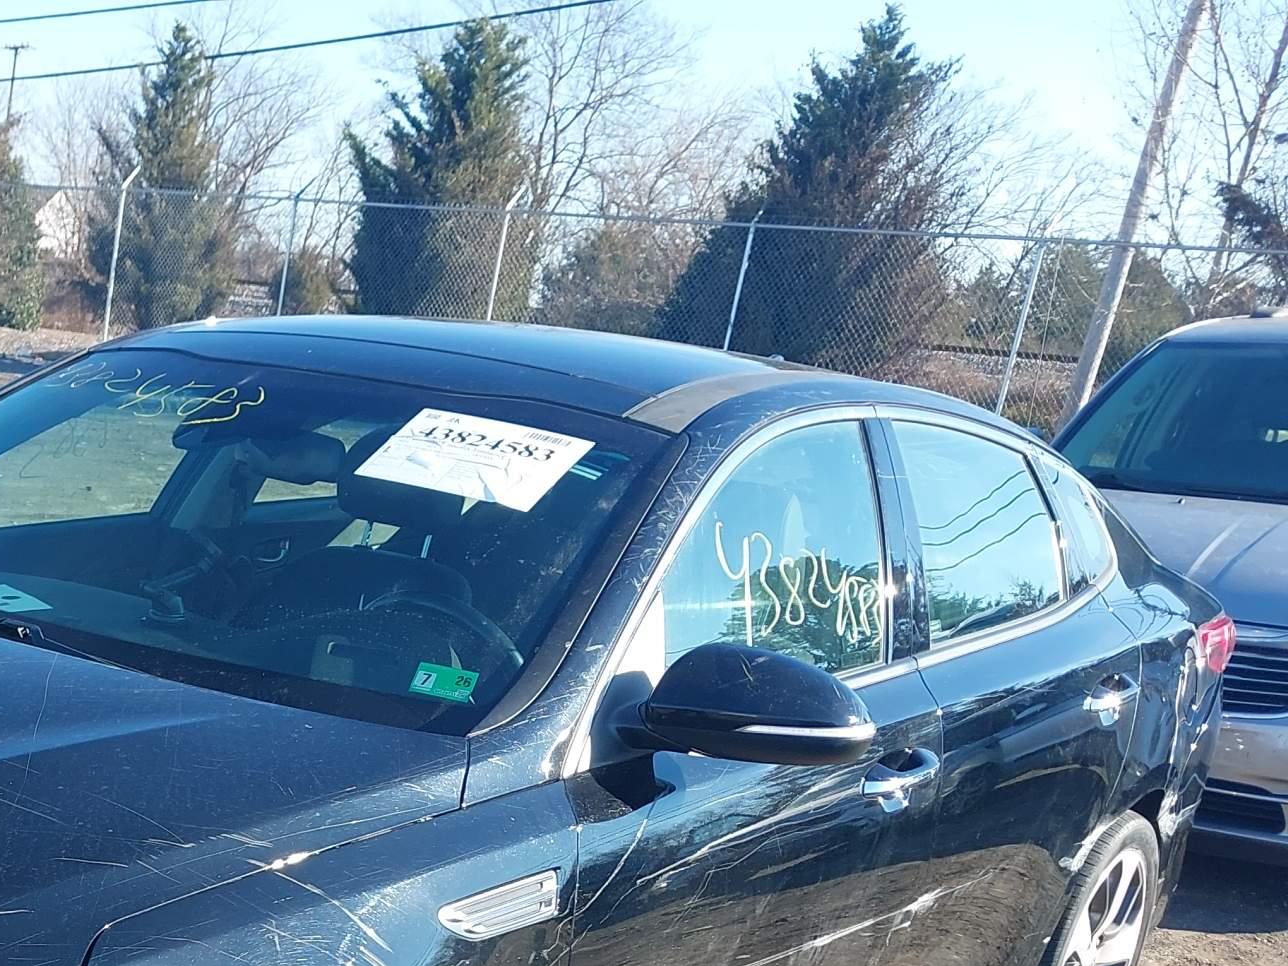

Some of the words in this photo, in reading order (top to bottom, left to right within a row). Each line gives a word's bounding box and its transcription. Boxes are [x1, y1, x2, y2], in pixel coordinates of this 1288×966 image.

[419, 425, 556, 462] 43824583
[420, 672, 433, 686] 7
[454, 675, 473, 688] 26
